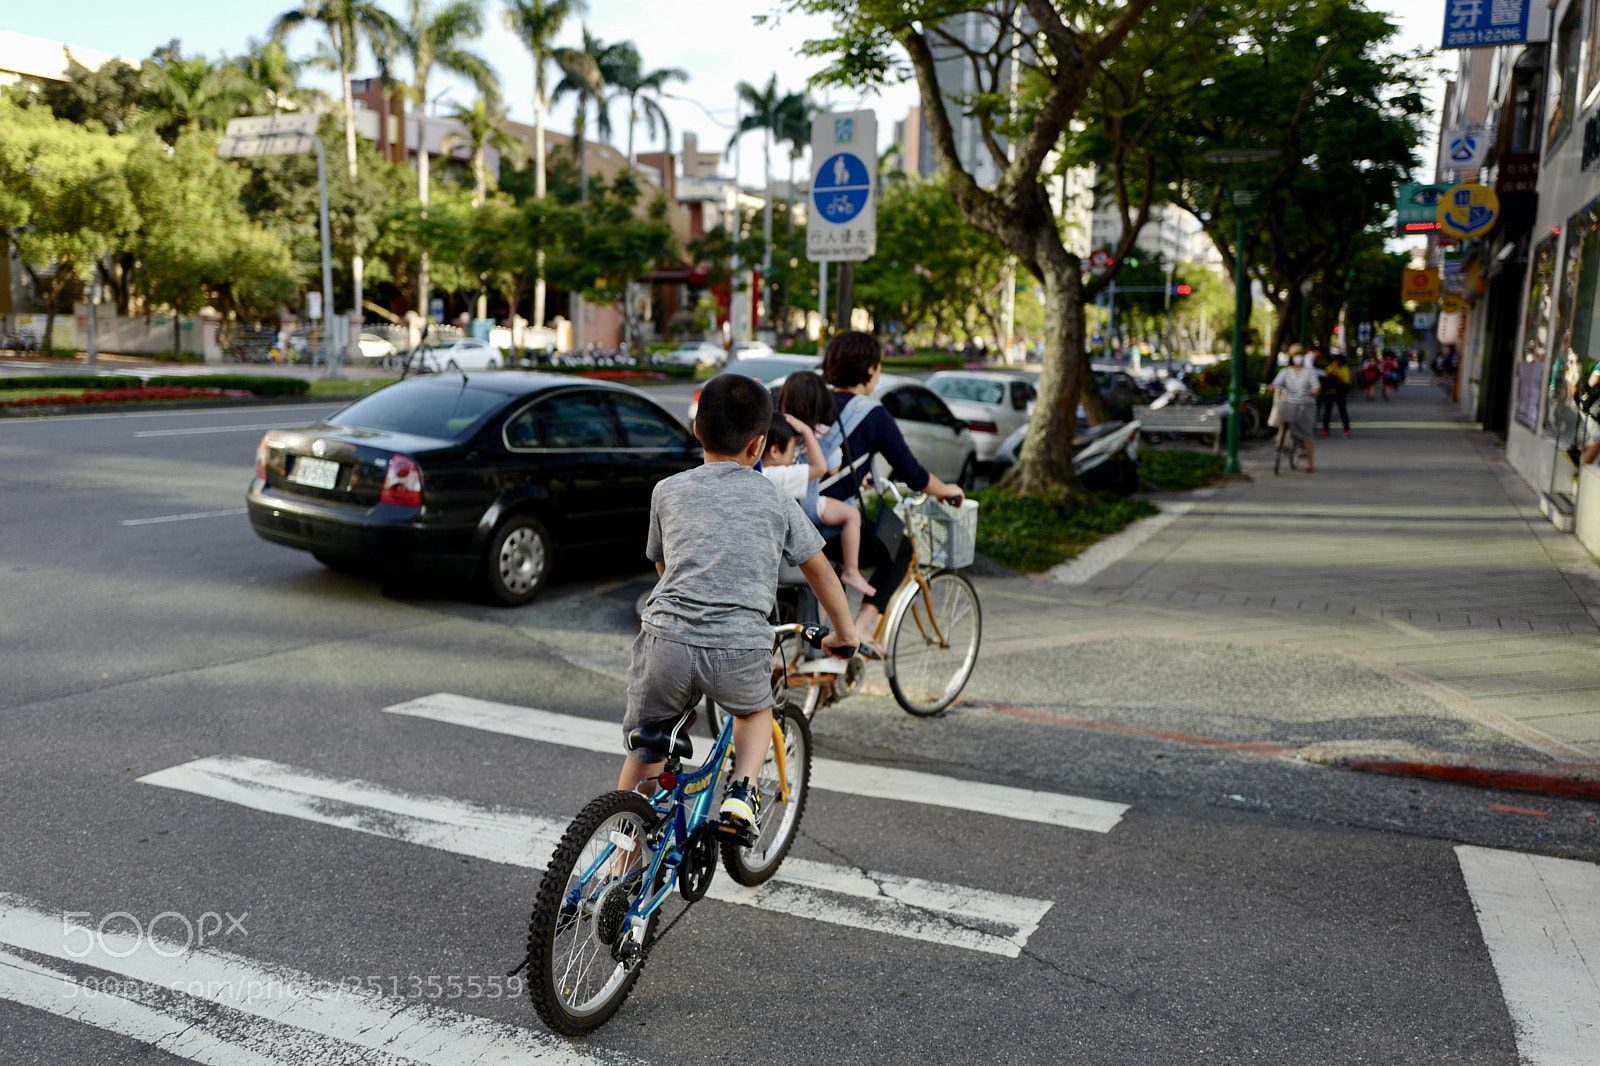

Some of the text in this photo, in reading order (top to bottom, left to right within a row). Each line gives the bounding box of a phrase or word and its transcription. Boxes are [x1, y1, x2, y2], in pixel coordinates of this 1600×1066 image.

[810, 228, 868, 245] 行人優先
[684, 773, 713, 795] GIANT
